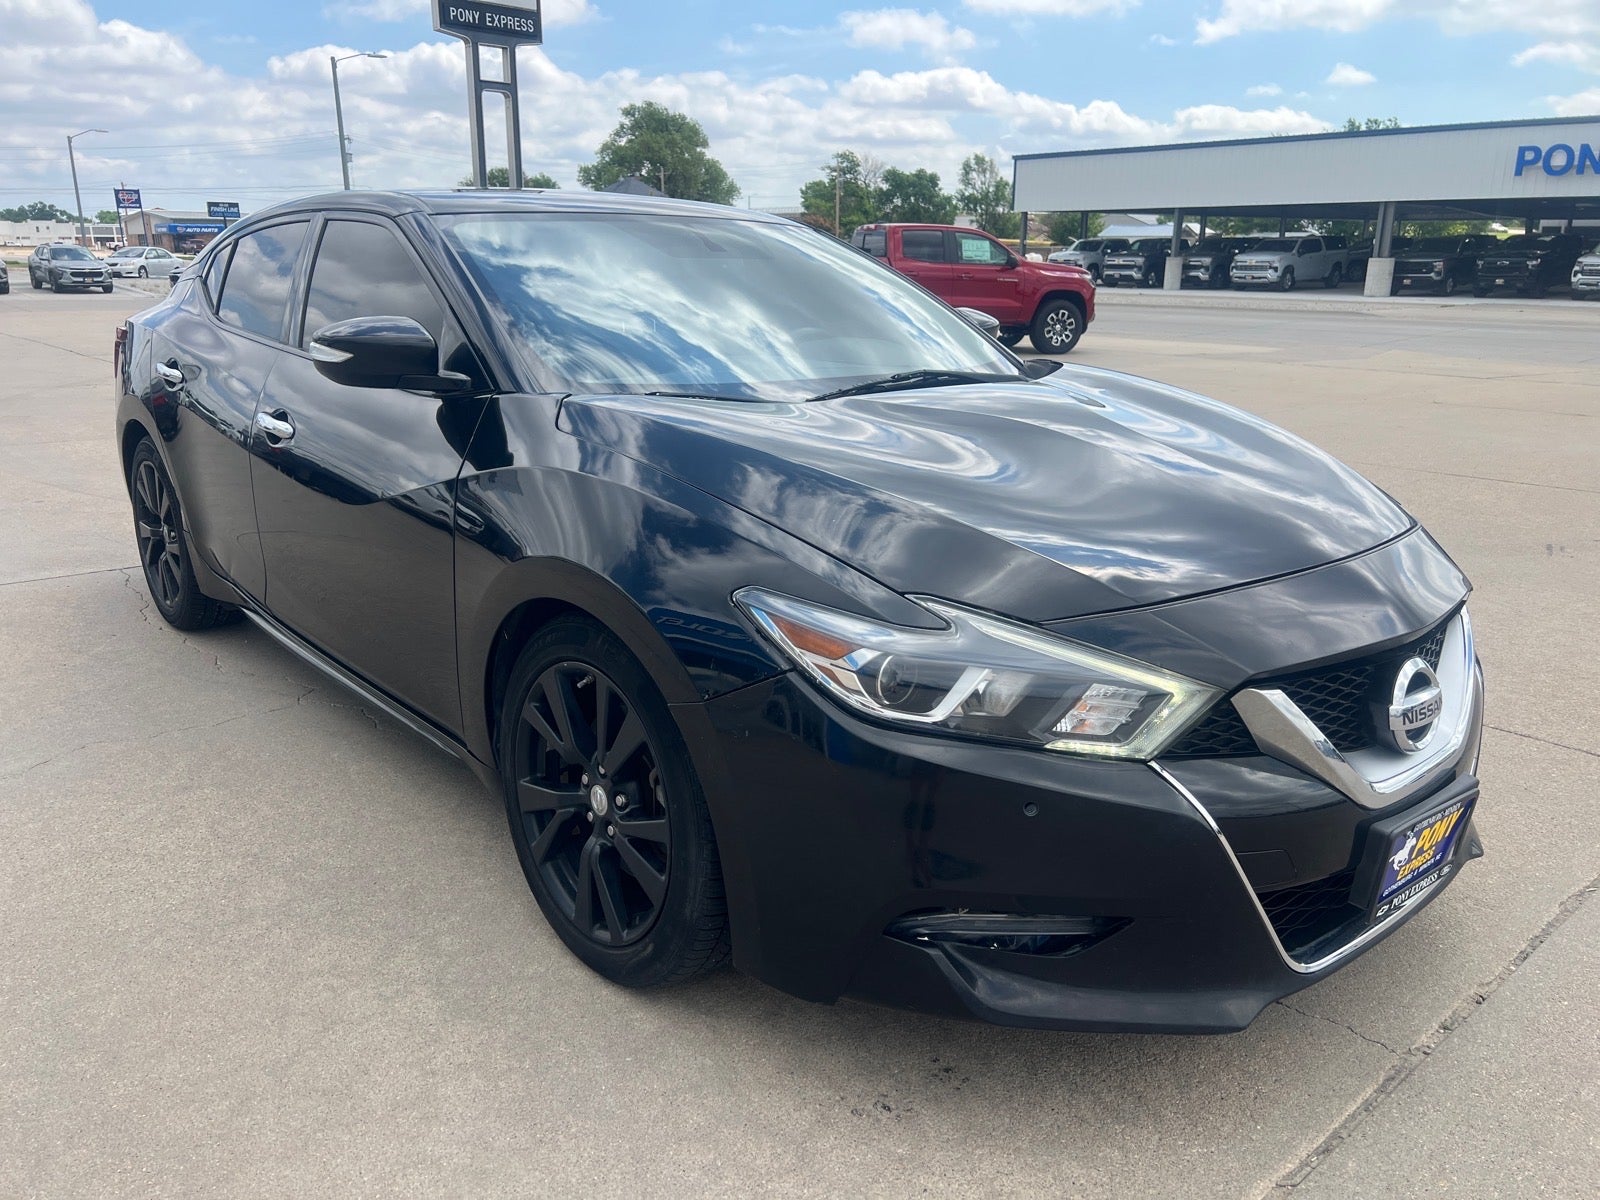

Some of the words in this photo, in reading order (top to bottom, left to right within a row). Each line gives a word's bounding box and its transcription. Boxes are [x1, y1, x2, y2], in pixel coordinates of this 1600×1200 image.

[450, 7, 479, 23] PONY
[486, 13, 533, 32] EXPRESS
[1514, 143, 1600, 177] PON
[1411, 807, 1464, 859] PONY
[1396, 846, 1436, 881] EXPRESS
[1390, 887, 1411, 909] PONY
[1409, 870, 1440, 896] EXPRESS
